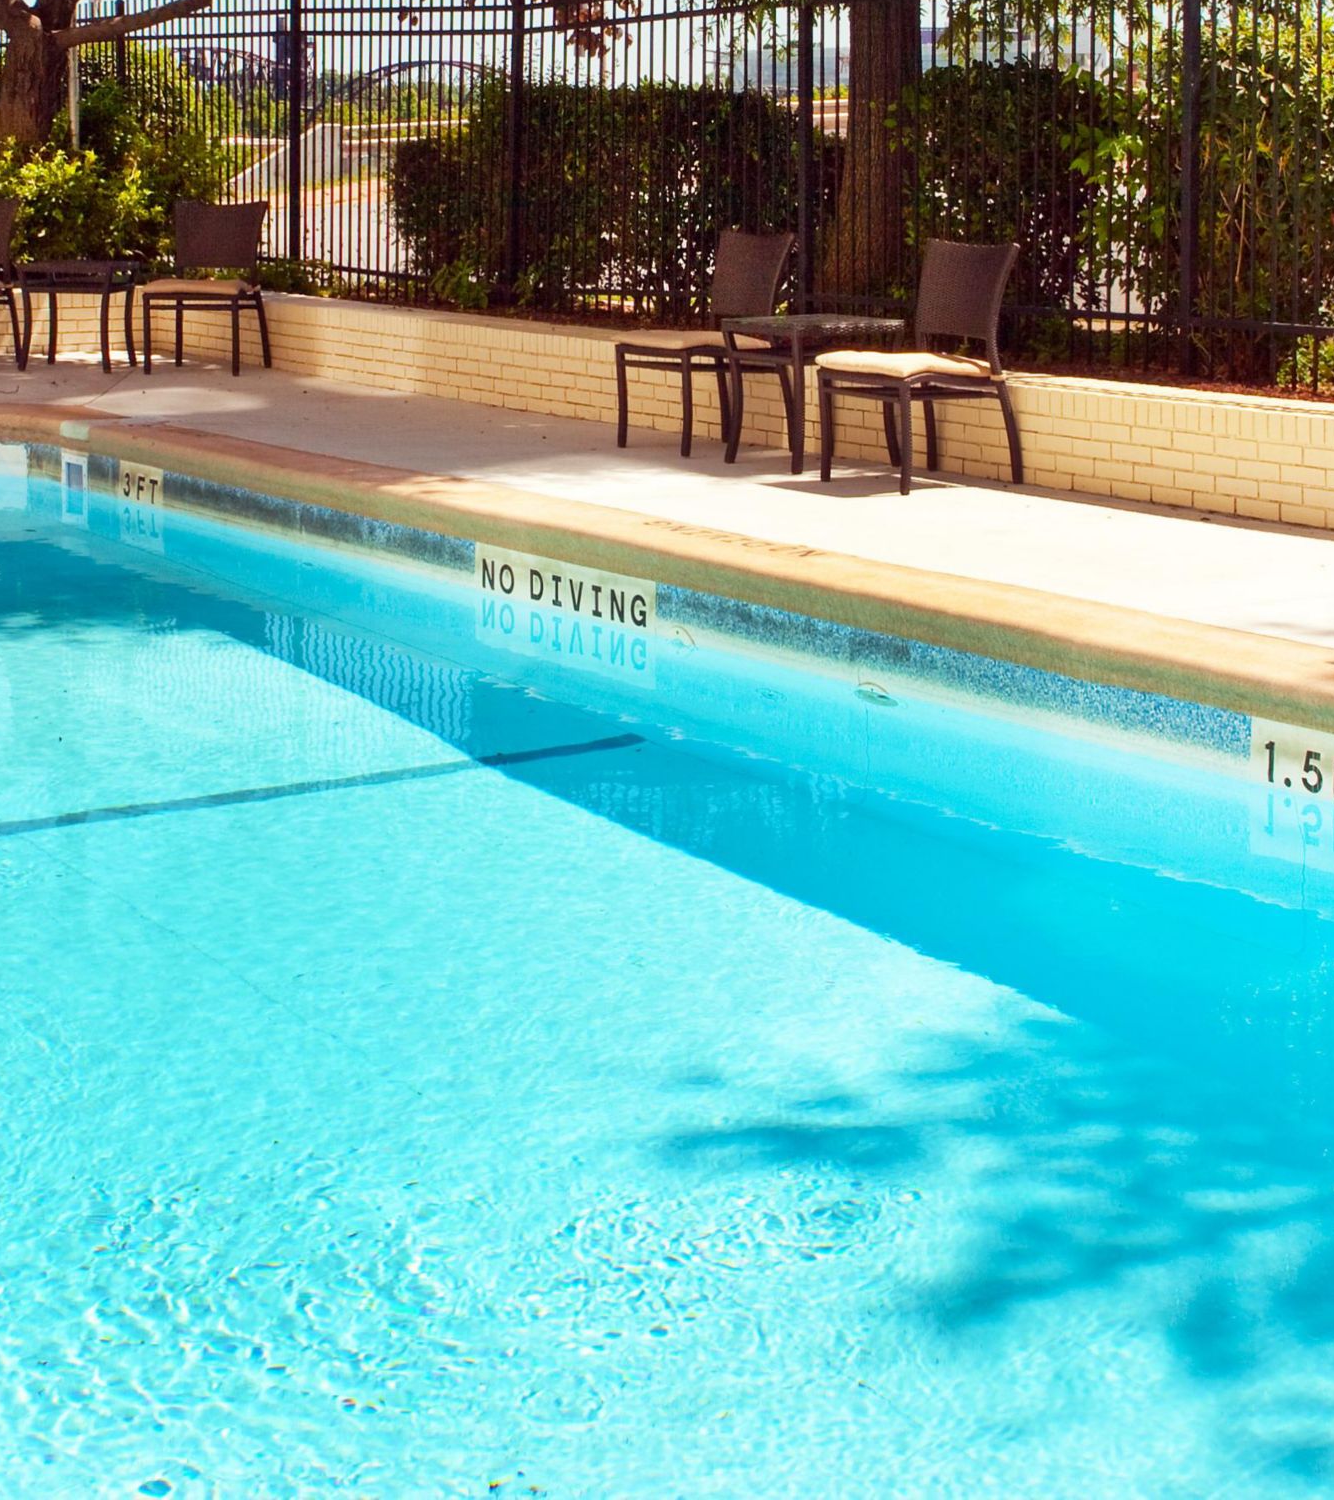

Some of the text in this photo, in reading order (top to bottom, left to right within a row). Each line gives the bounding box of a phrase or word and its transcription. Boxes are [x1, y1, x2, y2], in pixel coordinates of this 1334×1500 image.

[123, 472, 158, 505] 3 FT
[481, 558, 648, 629] NO DIVING
